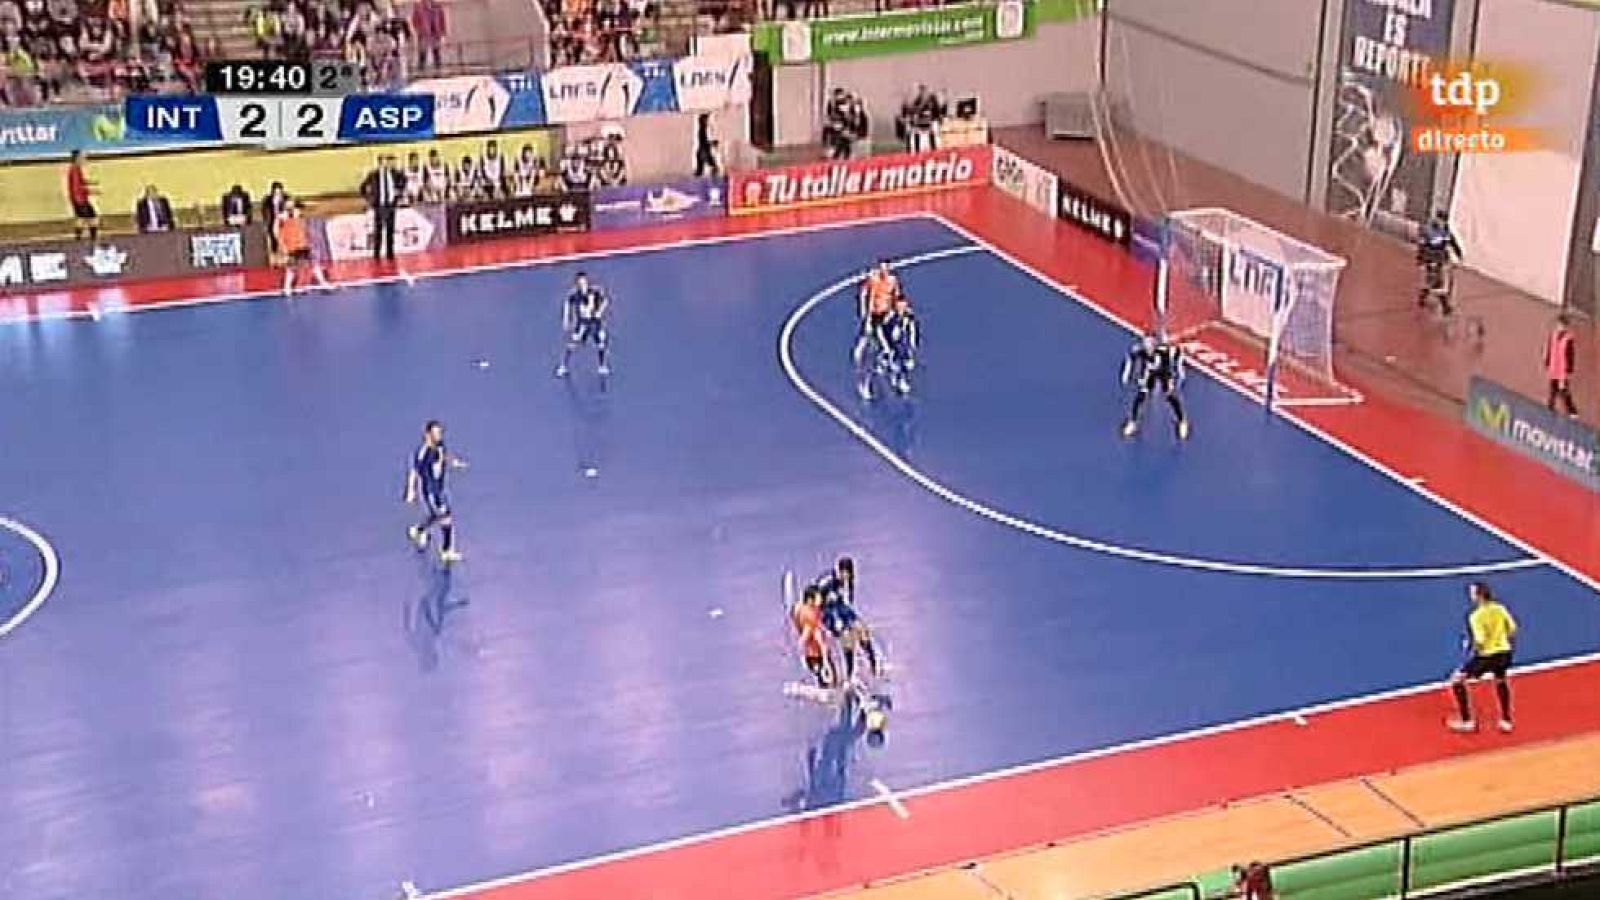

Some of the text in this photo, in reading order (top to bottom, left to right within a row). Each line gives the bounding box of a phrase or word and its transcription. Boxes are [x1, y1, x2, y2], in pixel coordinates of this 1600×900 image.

[1384, 13, 1408, 46] ES
[766, 173, 797, 204] Tu
[800, 164, 879, 199] taller
[878, 152, 973, 190] motrio
[461, 206, 551, 232] KELME
[1513, 419, 1593, 471] movistar
